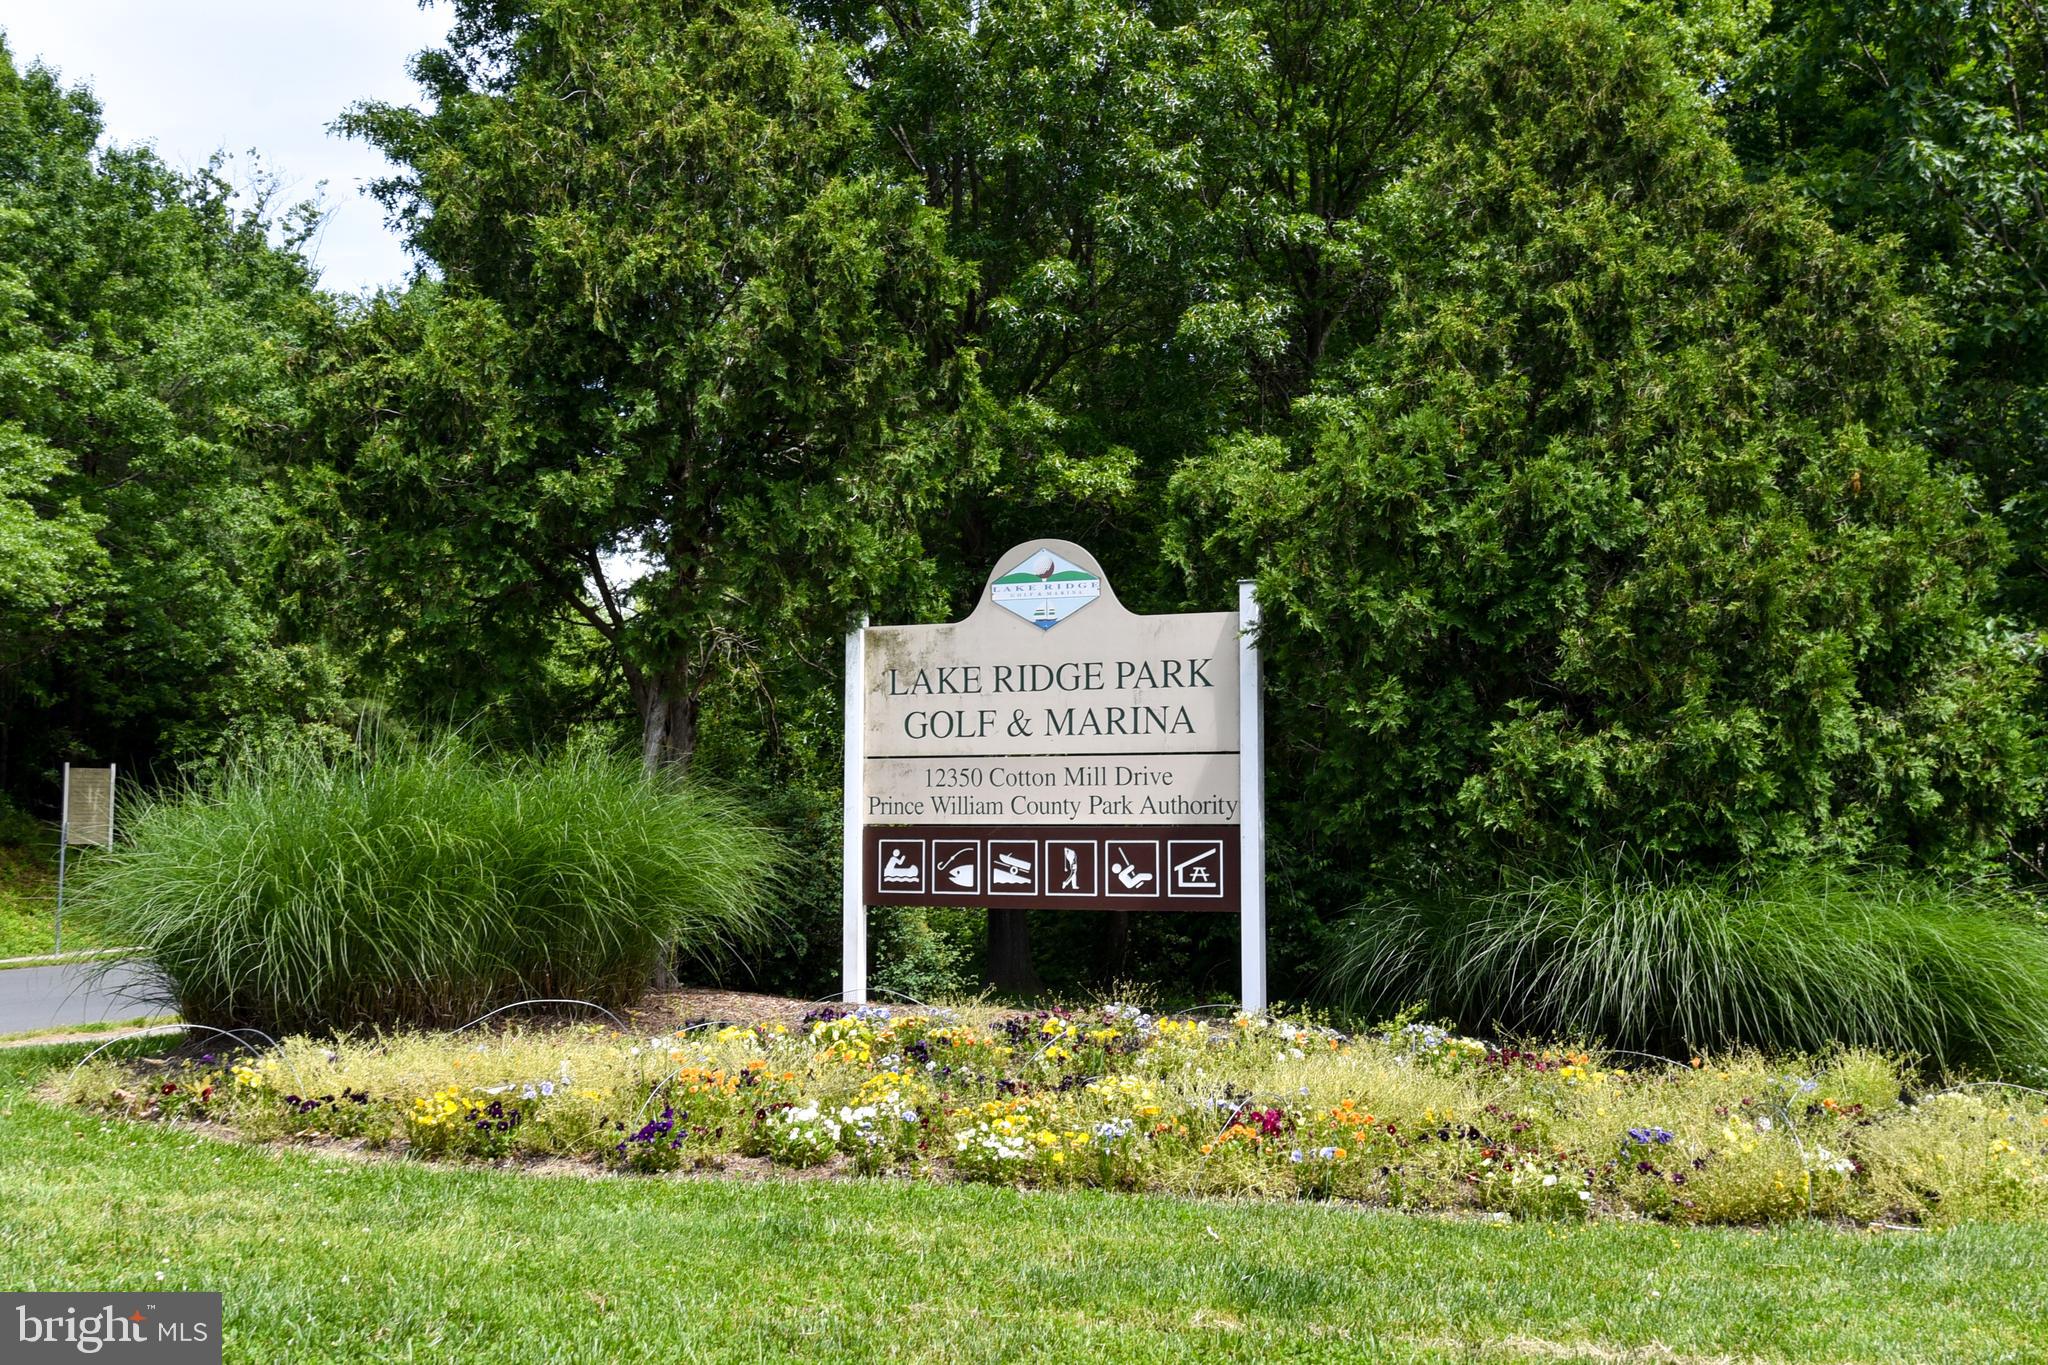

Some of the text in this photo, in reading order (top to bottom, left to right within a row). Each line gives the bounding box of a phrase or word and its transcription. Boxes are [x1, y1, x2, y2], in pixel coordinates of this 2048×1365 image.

[993, 582, 1099, 592] LAKE RIDGE
[889, 658, 1214, 696] LAKE RIDGE PARK
[904, 705, 1196, 740] GOLF & MARINA
[925, 766, 1174, 788] 12350 Cotton Mill Drive
[868, 794, 1239, 820] Prince William County Park Authority
